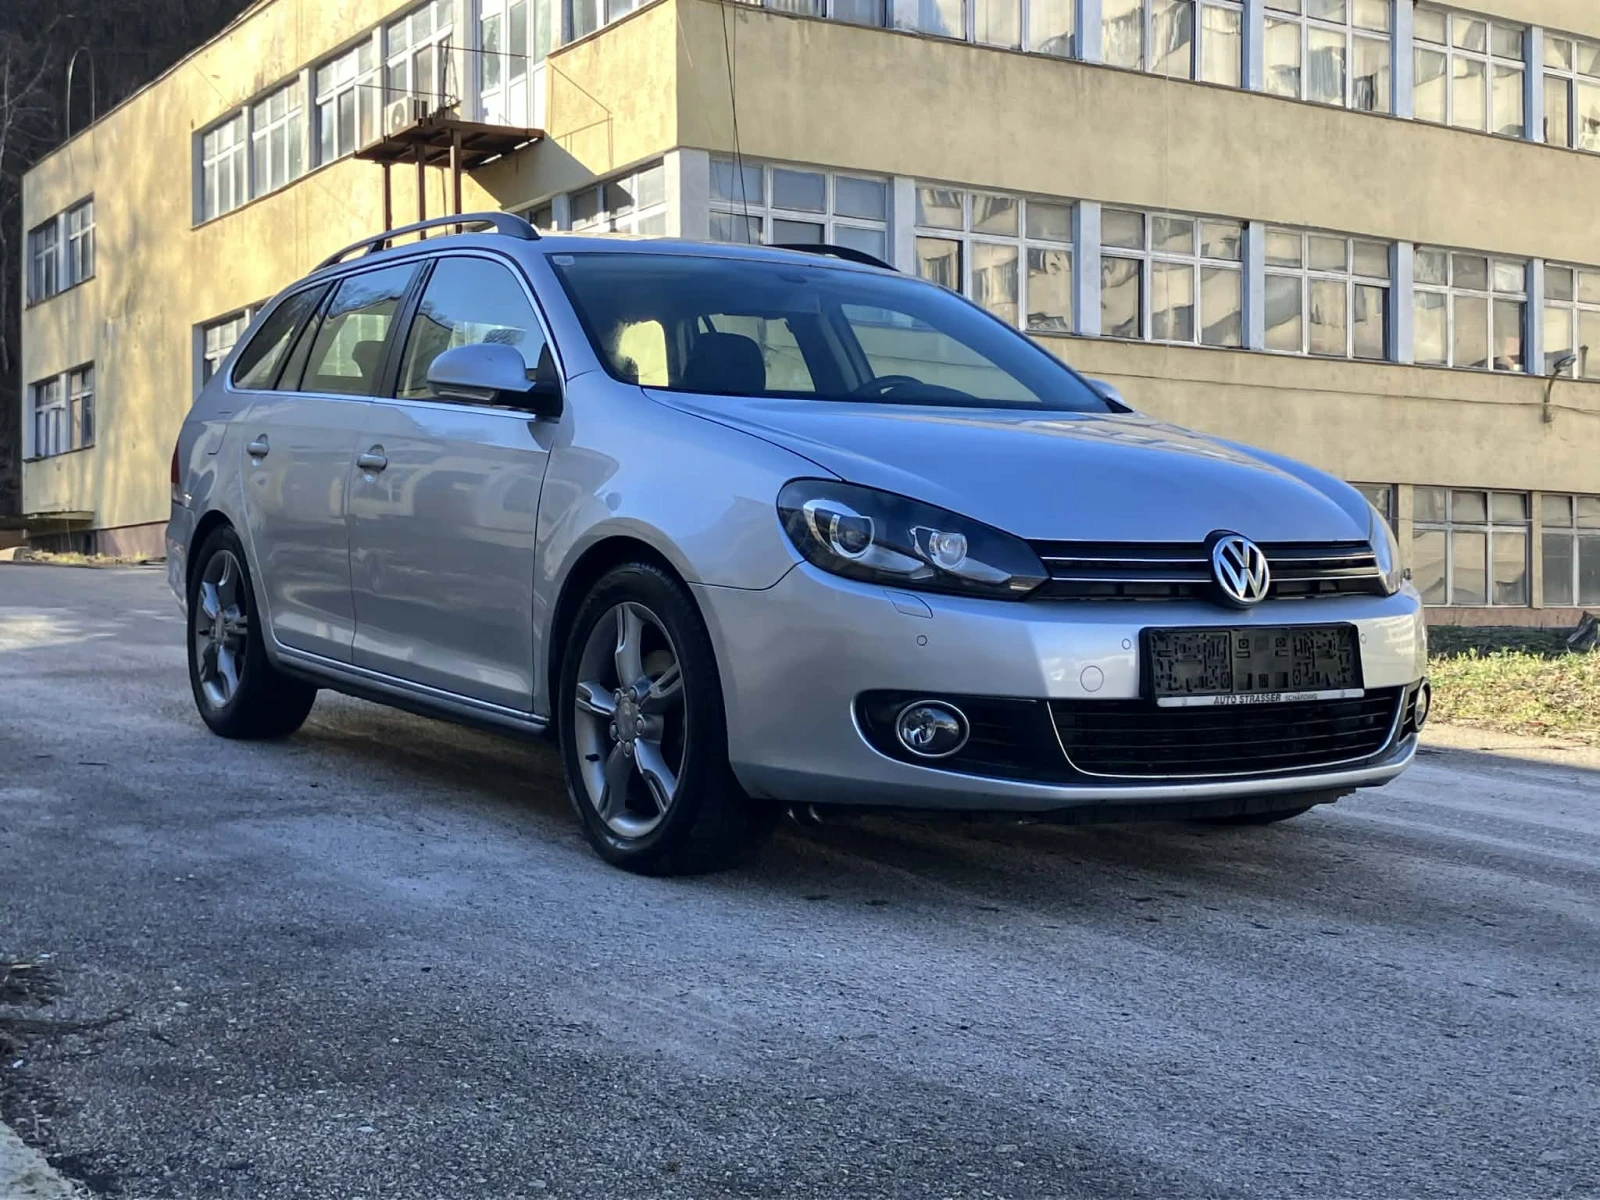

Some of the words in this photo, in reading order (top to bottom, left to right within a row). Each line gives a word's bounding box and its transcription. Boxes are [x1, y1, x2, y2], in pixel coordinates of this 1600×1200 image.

[1214, 536, 1269, 601] VW
[1213, 694, 1237, 706] AUTO
[1239, 693, 1282, 704] STRASSER
